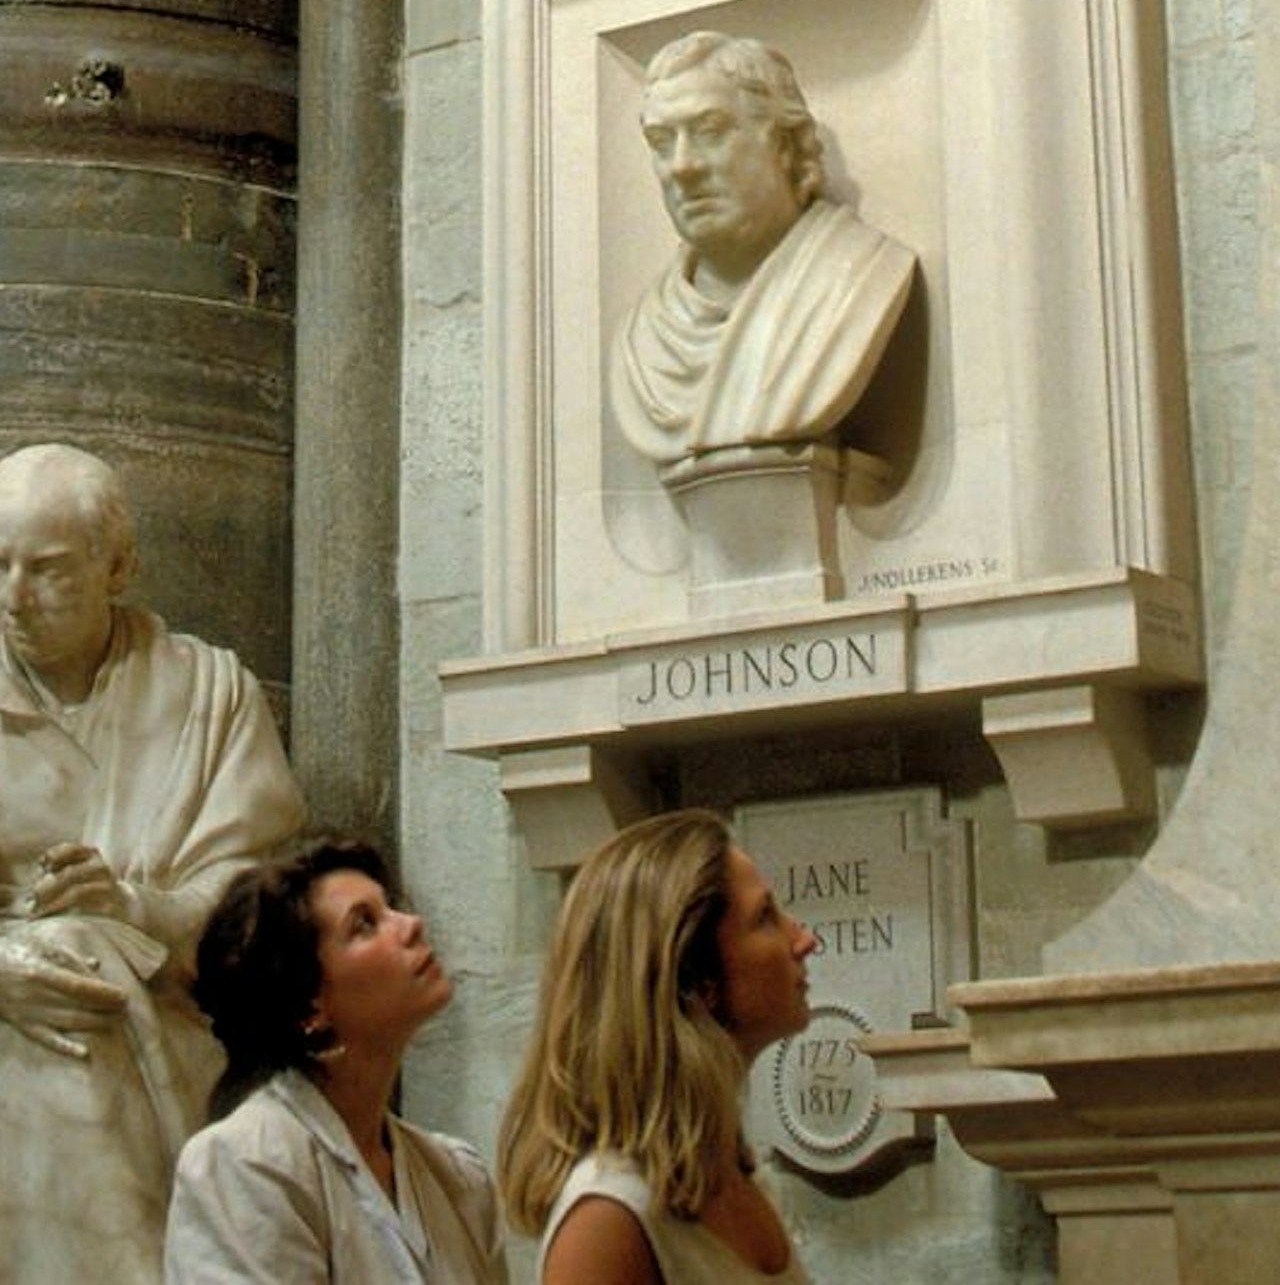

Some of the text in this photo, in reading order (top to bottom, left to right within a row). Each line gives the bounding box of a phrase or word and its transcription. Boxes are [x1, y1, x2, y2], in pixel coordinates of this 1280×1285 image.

[636, 634, 877, 705] JOHNSON
[784, 859, 871, 905] JANE
[798, 1038, 857, 1067] 1775
[798, 1086, 854, 1115] 1817
